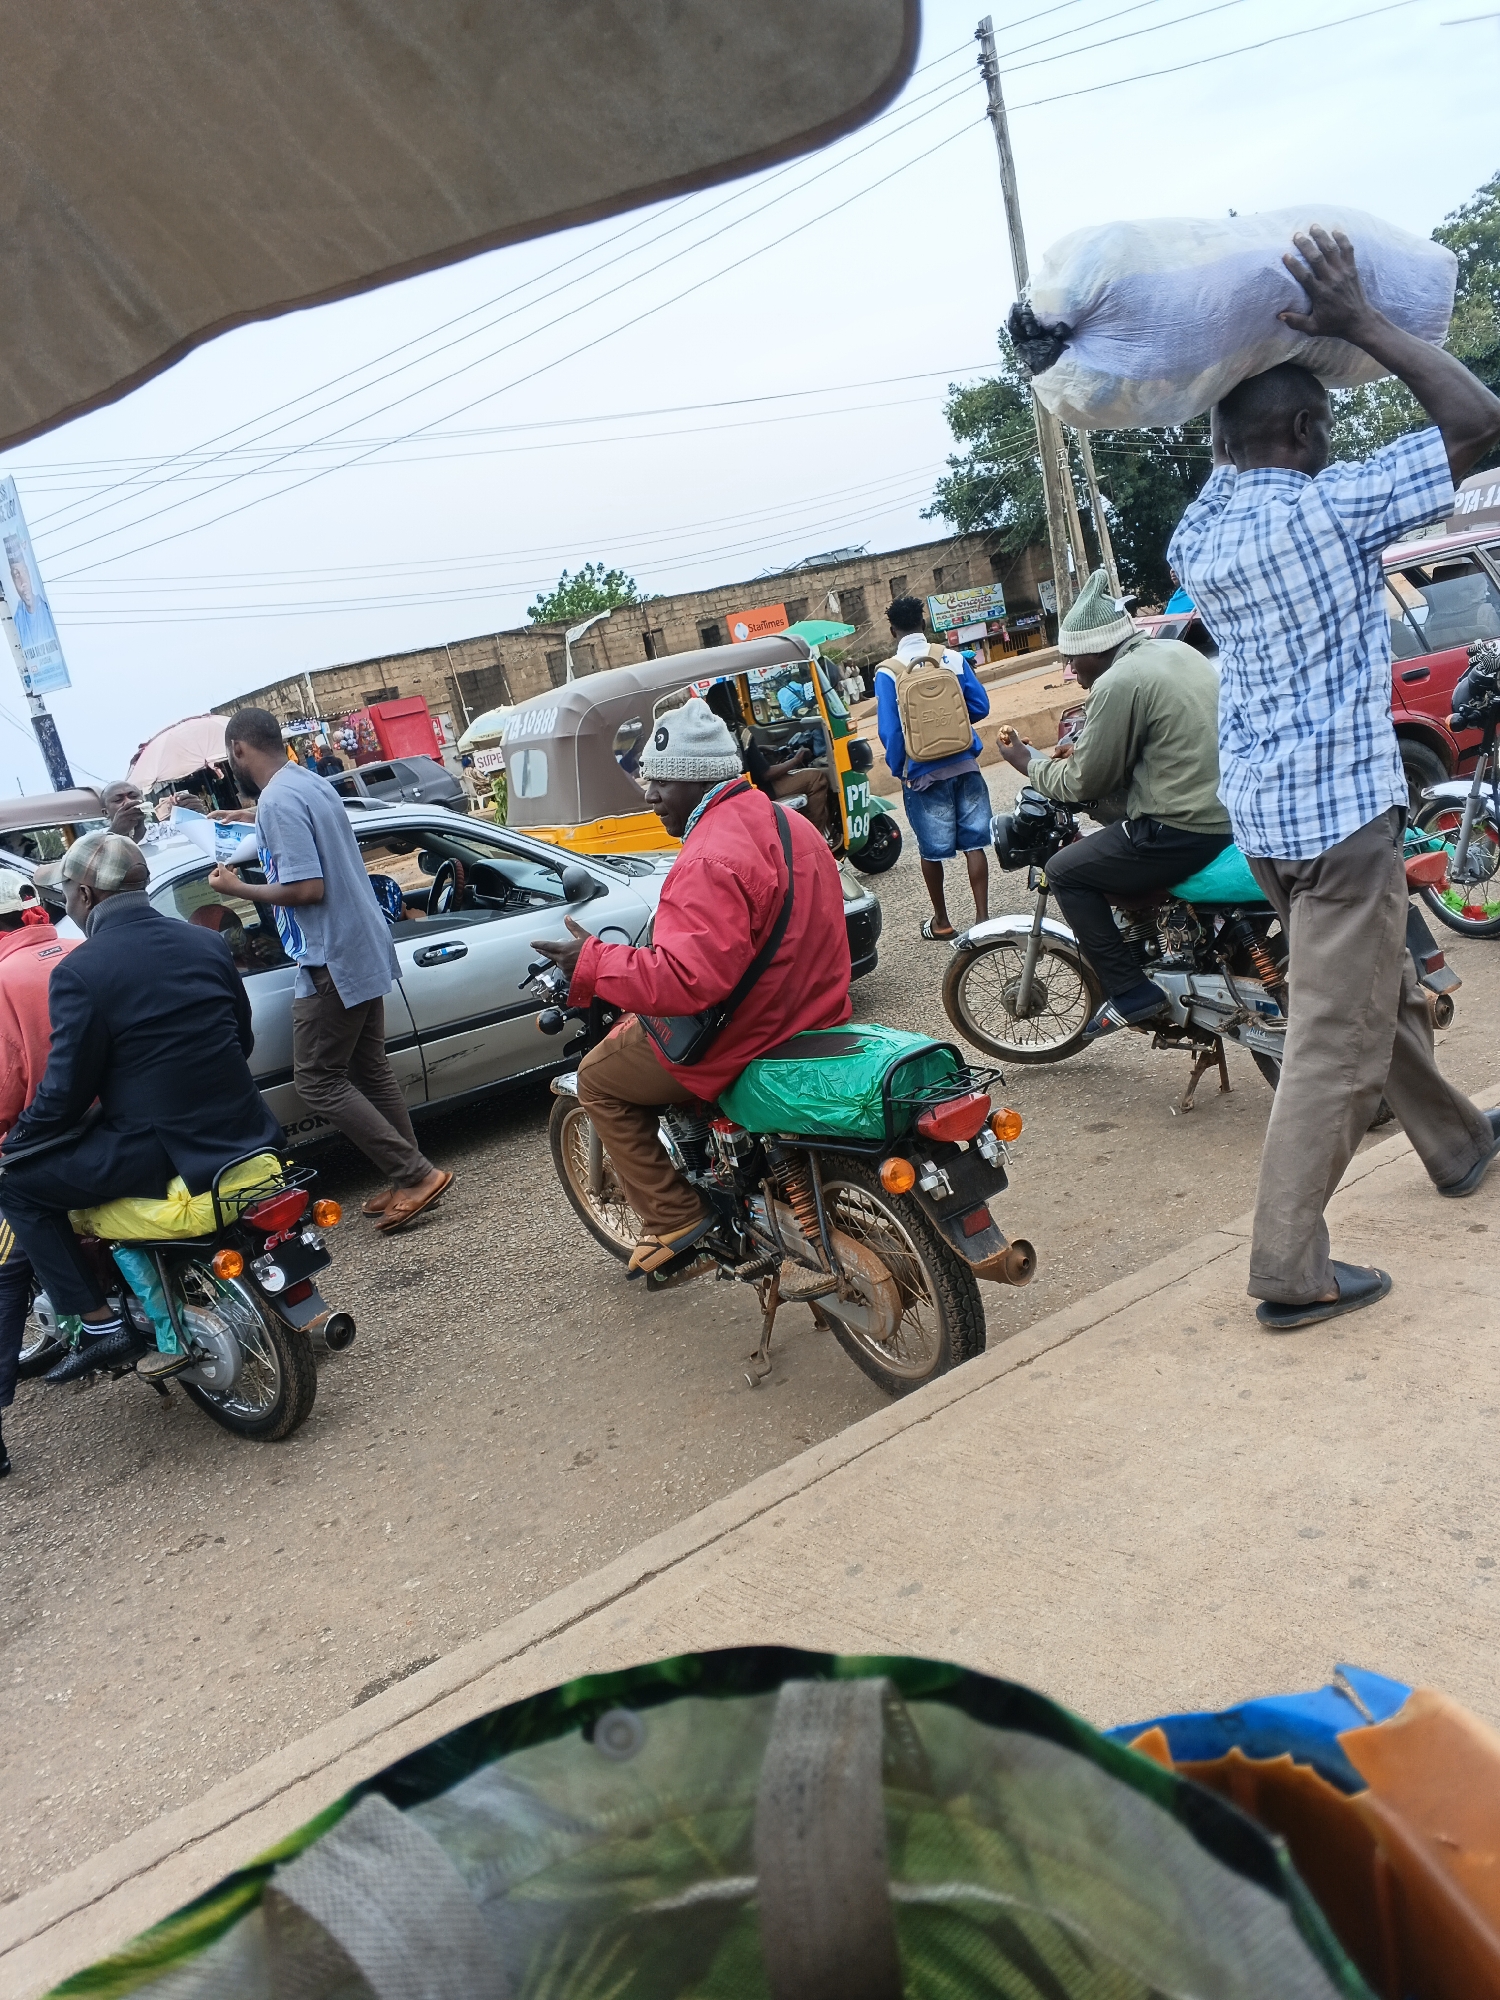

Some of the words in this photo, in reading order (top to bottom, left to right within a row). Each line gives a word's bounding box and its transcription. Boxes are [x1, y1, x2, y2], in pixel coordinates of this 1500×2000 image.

[748, 618, 785, 633] StarTimes
[505, 706, 558, 740] PTA-10888
[476, 753, 502, 768] SUPE
[281, 1114, 331, 1137] HON
